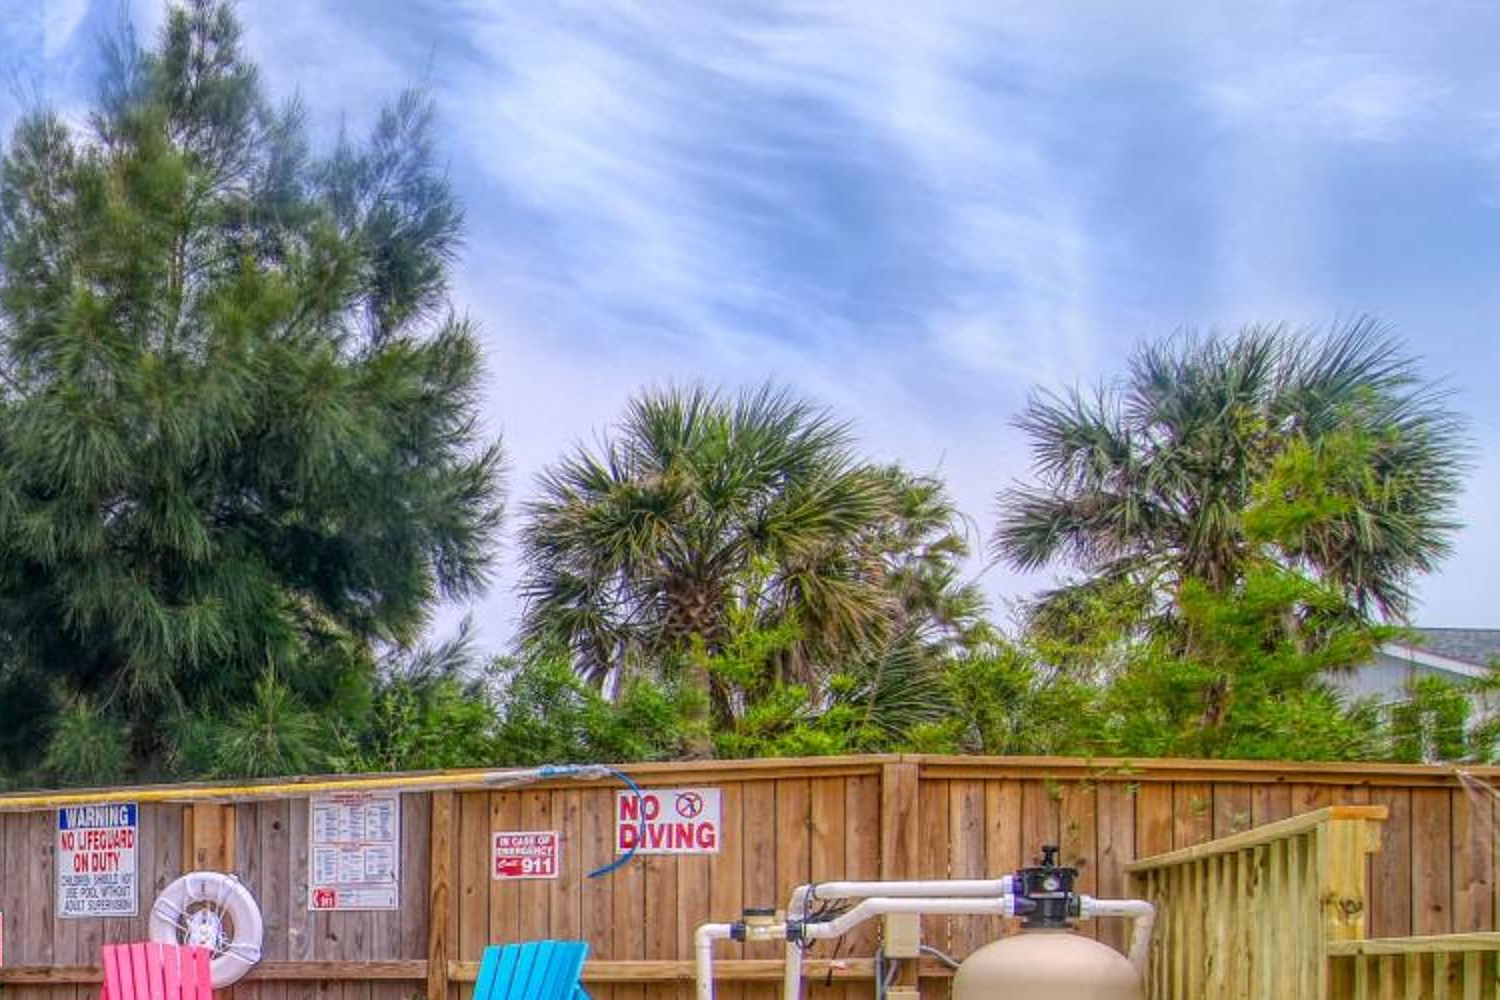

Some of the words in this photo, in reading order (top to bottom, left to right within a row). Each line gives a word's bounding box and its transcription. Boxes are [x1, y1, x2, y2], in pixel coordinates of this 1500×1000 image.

[67, 805, 130, 828] WARNING
[620, 795, 659, 820] NO
[61, 831, 75, 850] NO
[77, 829, 133, 850] LIFEGUARD
[620, 822, 716, 848] DIVING
[74, 853, 88, 872] ON
[92, 851, 121, 871] DUTY
[521, 858, 550, 873] 911
[81, 886, 99, 899] POOL
